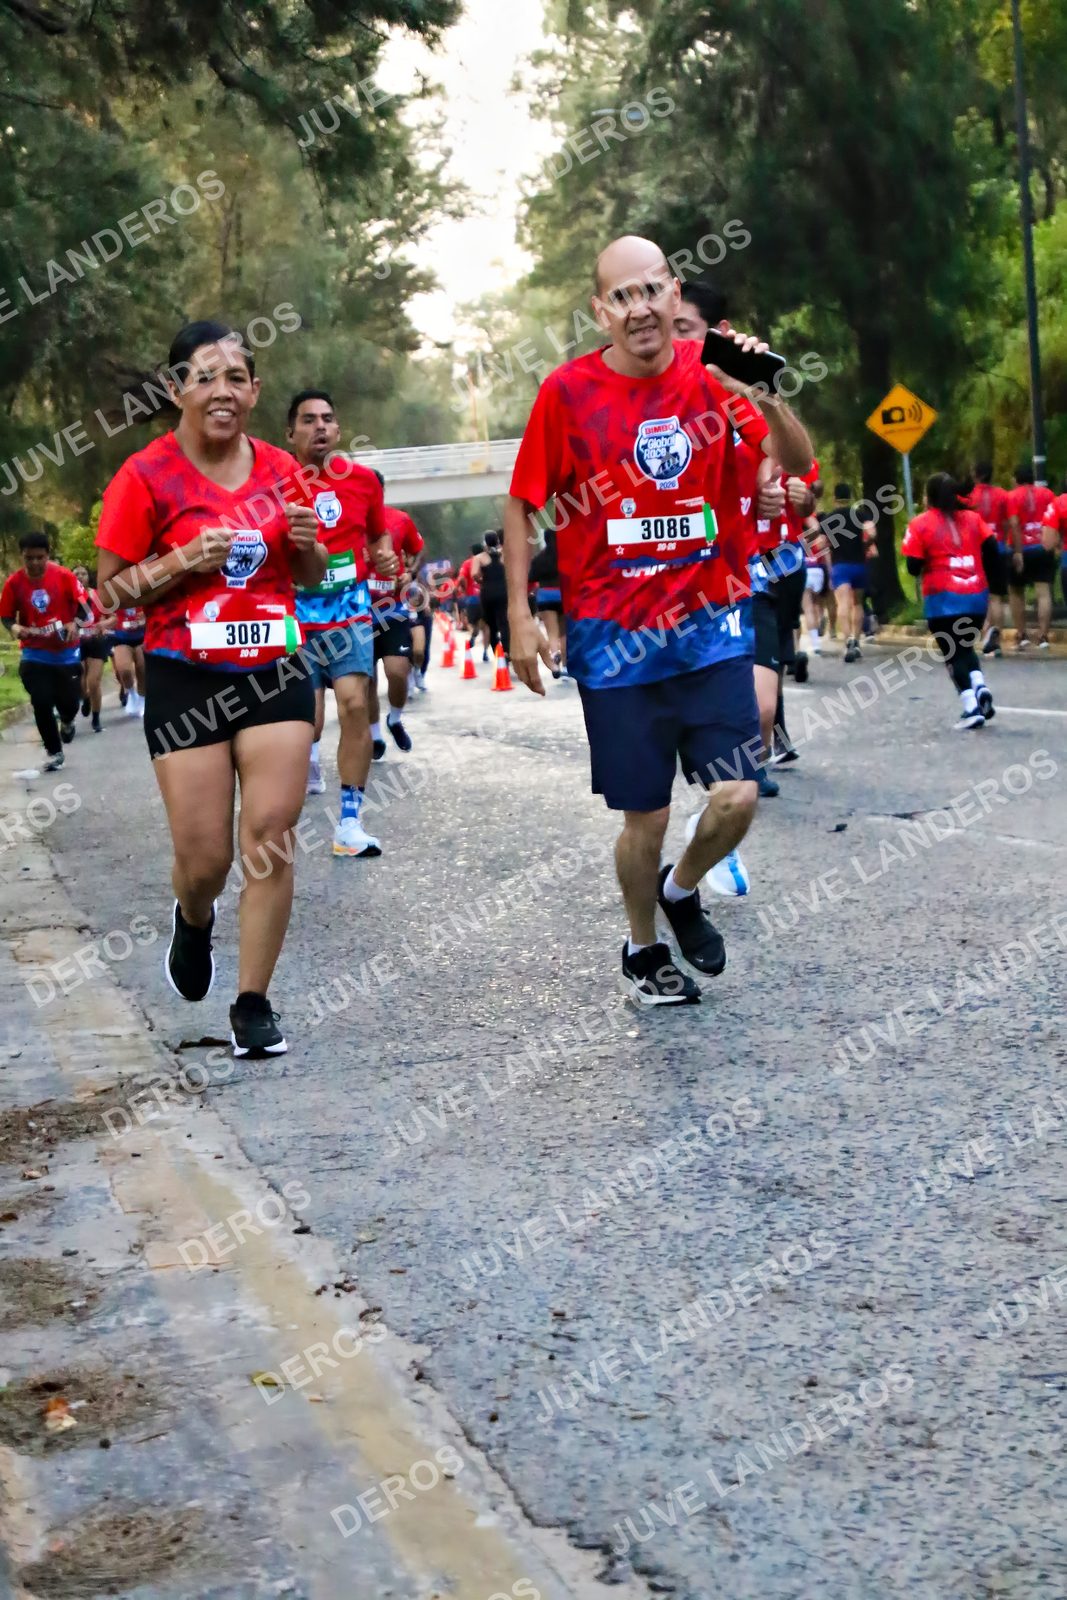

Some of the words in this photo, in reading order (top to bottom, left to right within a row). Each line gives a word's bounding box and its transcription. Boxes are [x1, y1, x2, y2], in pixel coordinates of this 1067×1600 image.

[645, 424, 674, 435] BIMBO
[648, 435, 676, 449] Global
[644, 448, 667, 460] Race
[641, 516, 690, 540] 3086
[226, 622, 271, 645] 3087
